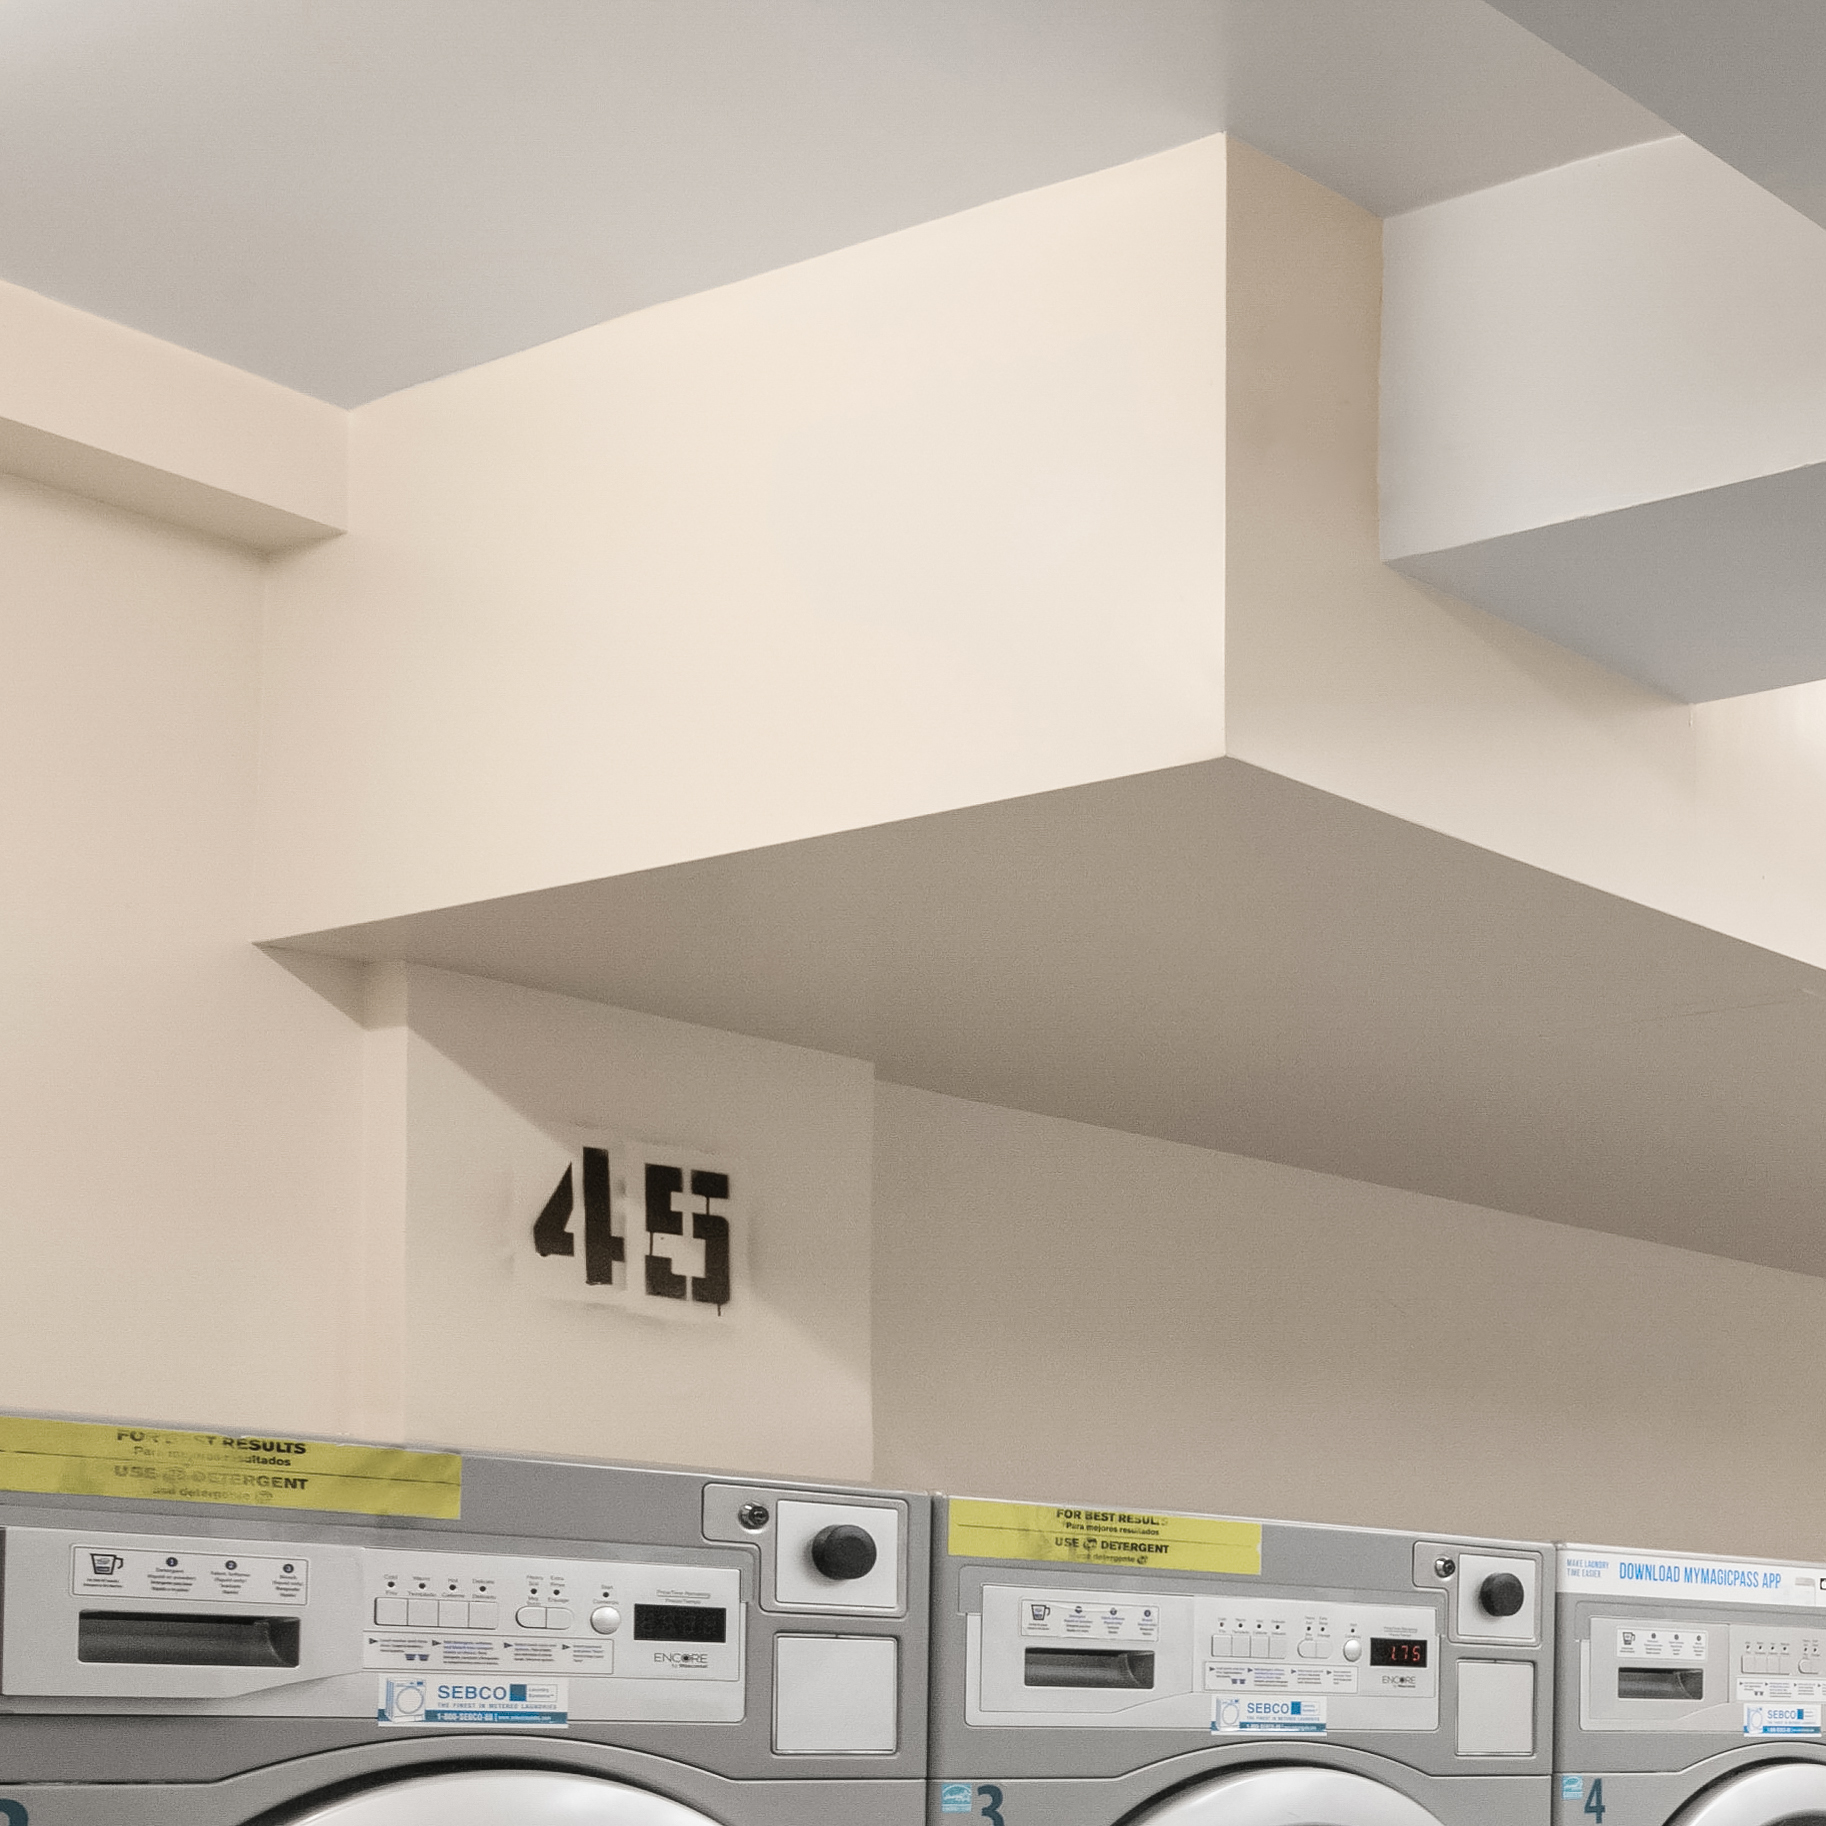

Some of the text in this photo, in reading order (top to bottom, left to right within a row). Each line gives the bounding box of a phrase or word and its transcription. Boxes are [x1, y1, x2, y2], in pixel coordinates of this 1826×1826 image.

[533, 1146, 730, 1305] 45
[222, 1437, 307, 1455] RESULTS
[114, 1466, 309, 1490] USE DETERGENT
[1056, 1509, 1082, 1520] FOR
[1085, 1511, 1115, 1522] BEST
[1066, 1522, 1084, 1530] Para
[1086, 1524, 1117, 1533] mejores
[1055, 1537, 1169, 1554] USE DETERGENT
[1619, 1562, 1781, 1588] DOWNLOAD MYMAGICPASS APP
[654, 1653, 708, 1664] ENCORE
[1382, 1676, 1416, 1685] ENCORE
[438, 1685, 507, 1700] SEBCO
[1247, 1702, 1289, 1714] SEBCO
[1767, 1710, 1796, 1719] SEBCO
[1584, 1778, 1606, 1824] 4
